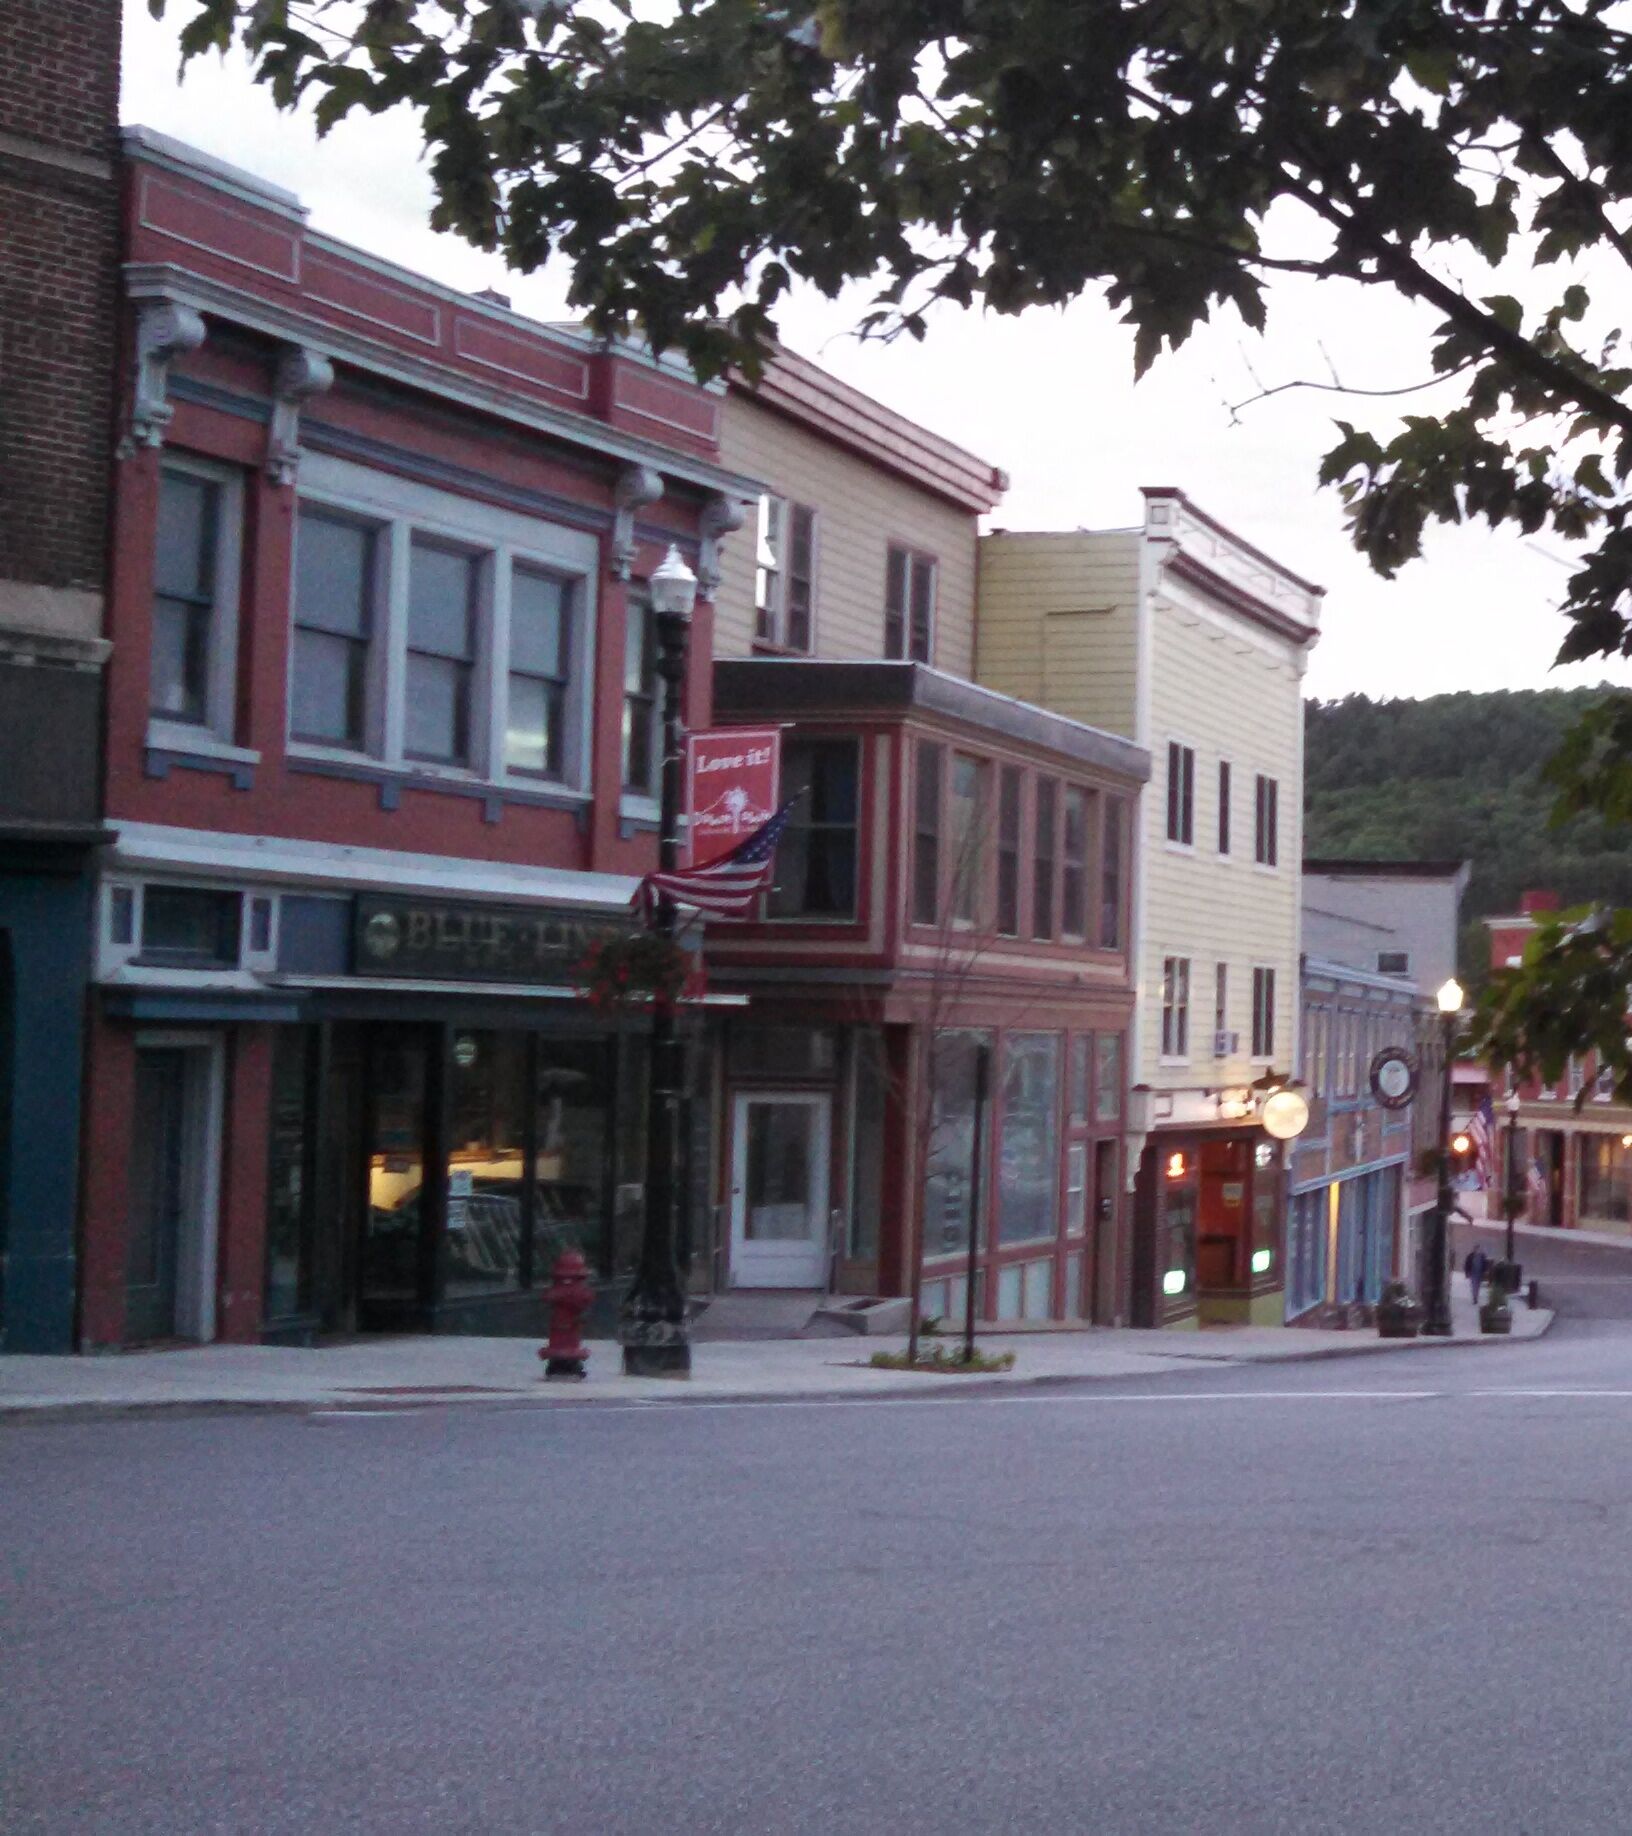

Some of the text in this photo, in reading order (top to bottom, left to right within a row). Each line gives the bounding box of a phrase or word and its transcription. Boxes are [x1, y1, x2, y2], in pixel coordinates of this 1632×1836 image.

[695, 746, 771, 774] Love it!
[407, 910, 511, 955] BLUE
